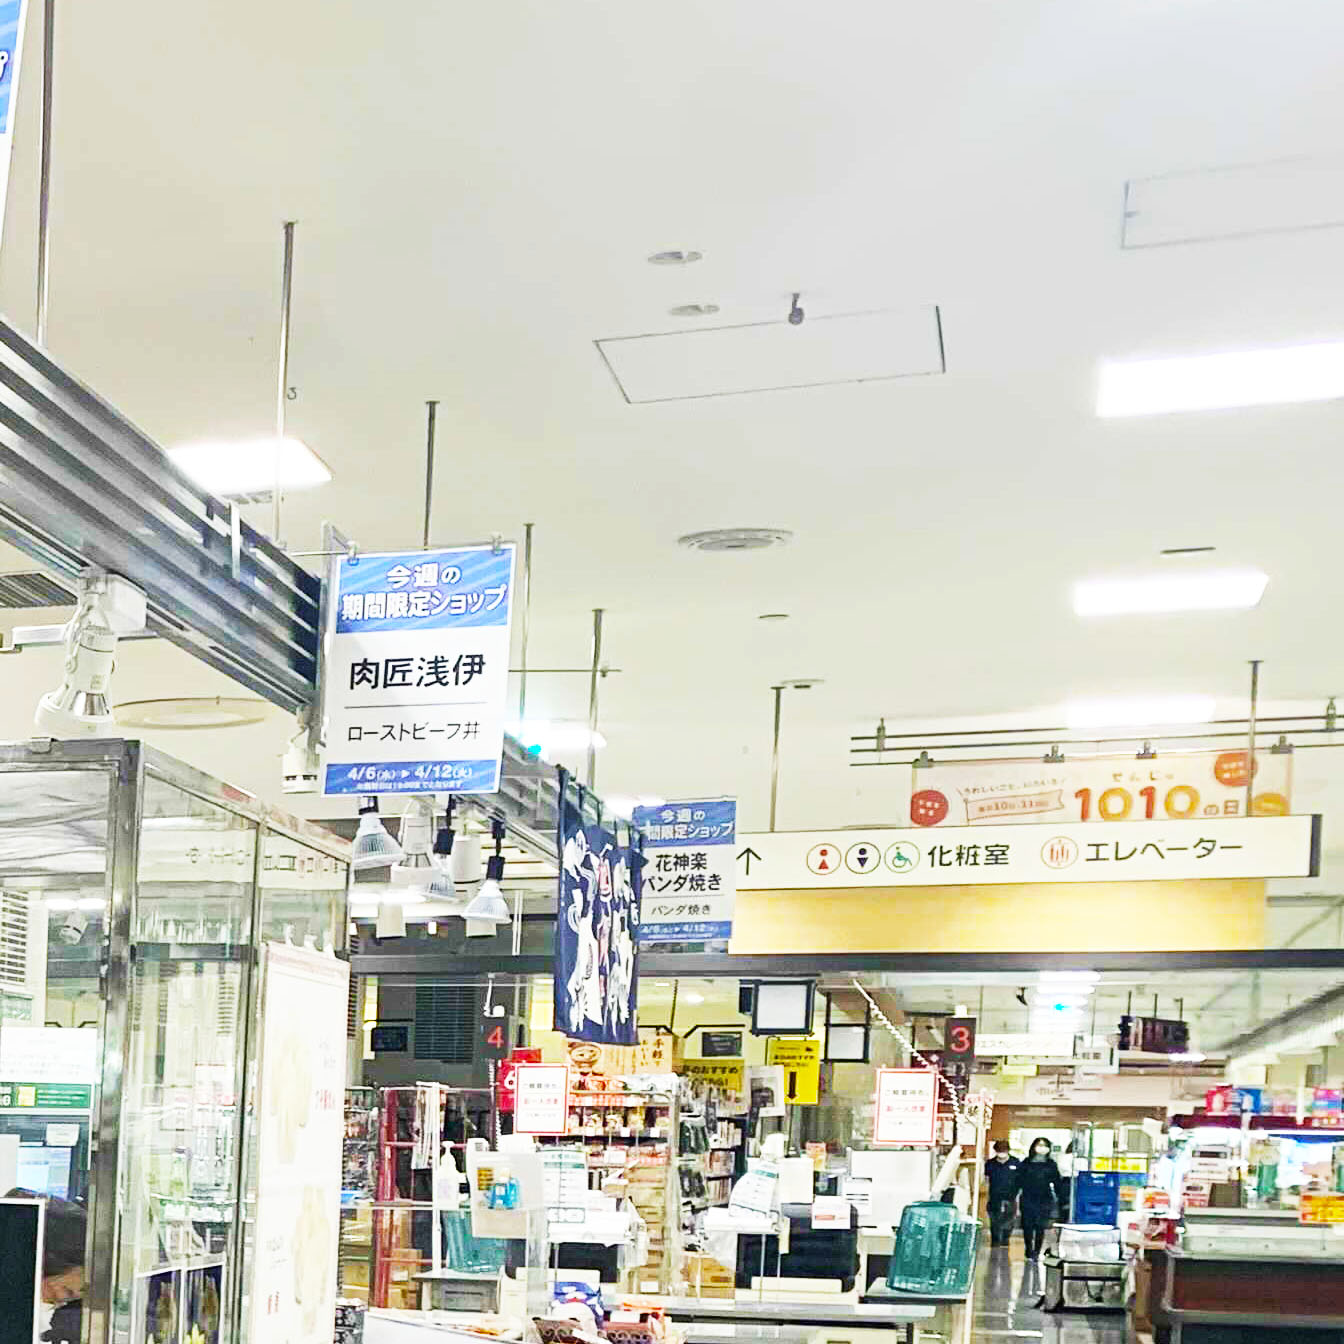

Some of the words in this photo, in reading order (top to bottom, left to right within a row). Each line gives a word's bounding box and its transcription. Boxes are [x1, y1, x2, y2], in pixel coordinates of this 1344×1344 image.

[386, 562, 461, 590] 今週の
[342, 585, 507, 621] 期間限定ショップ
[349, 654, 486, 690] 肉匠浅伊
[661, 808, 705, 823] 今週の
[656, 852, 707, 872] 花神楽
[928, 843, 1011, 869] 化粧室
[1086, 838, 1243, 863] エレベーター
[487, 1025, 505, 1049] 4
[951, 1026, 971, 1052] 3
